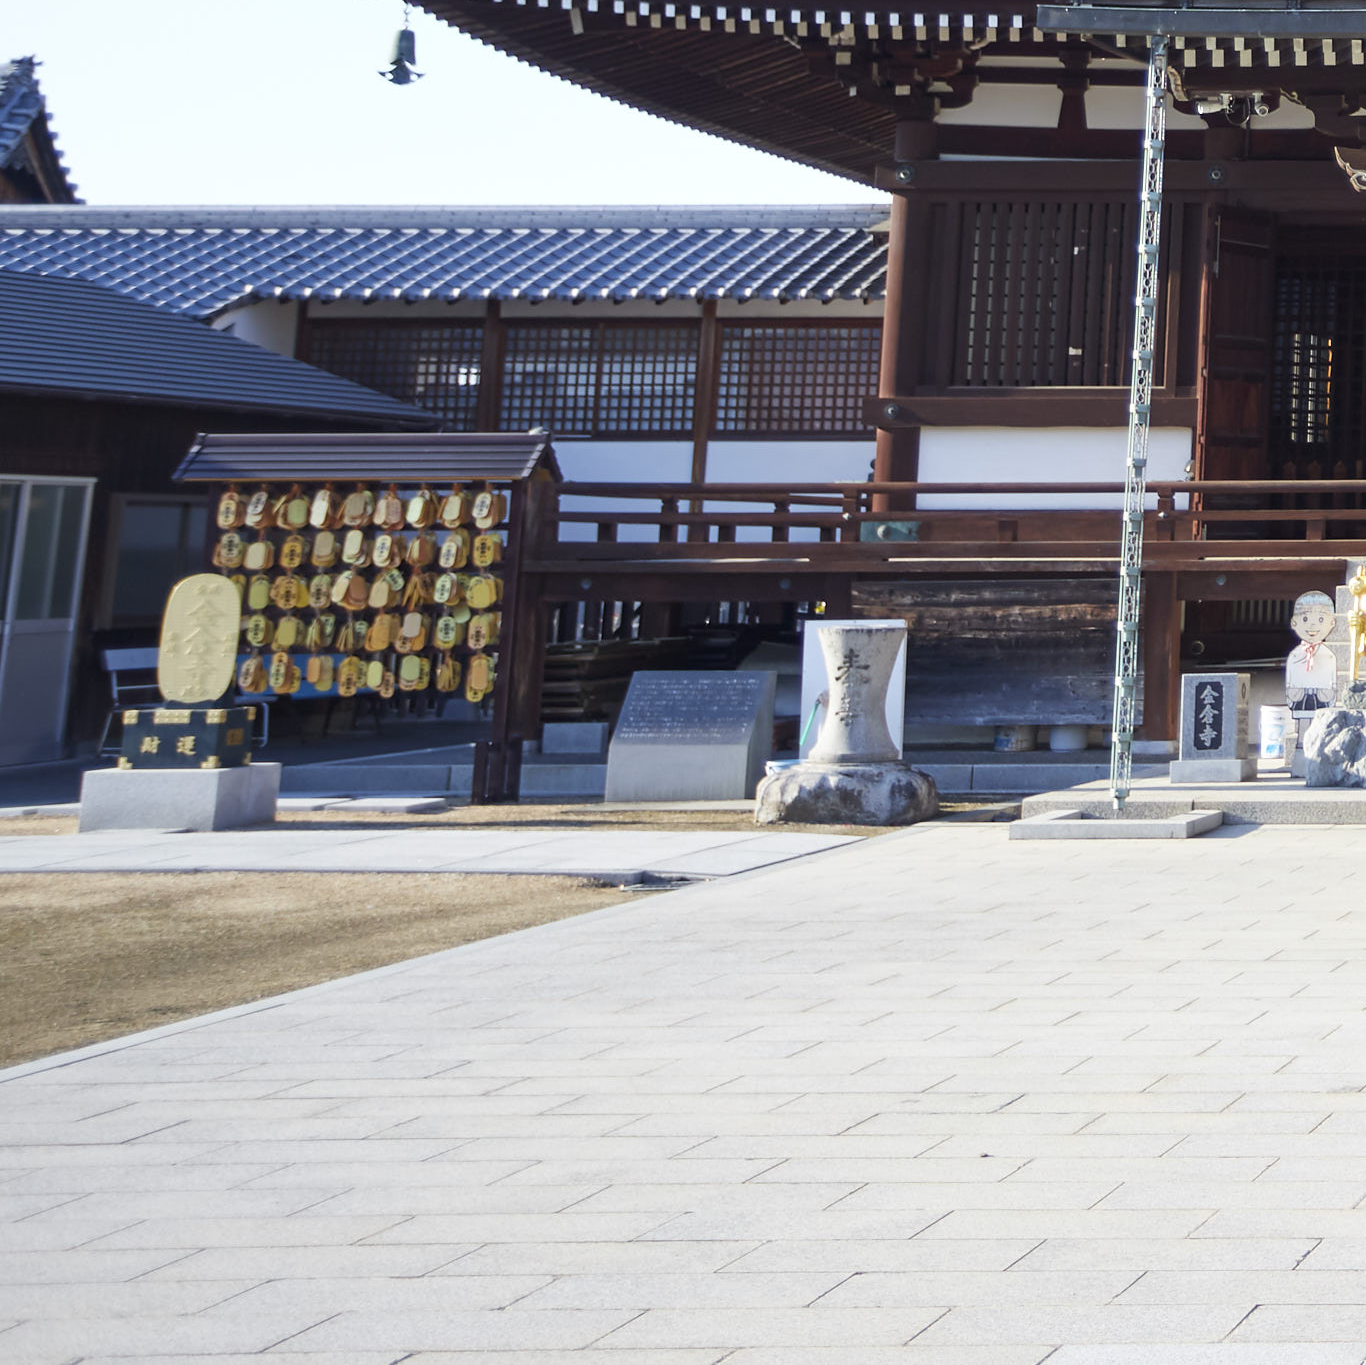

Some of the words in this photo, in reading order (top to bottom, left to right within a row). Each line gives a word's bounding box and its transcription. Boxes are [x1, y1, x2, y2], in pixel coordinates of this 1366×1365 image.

[1199, 684, 1220, 747] 金倉寺
[140, 736, 196, 755] 財運
